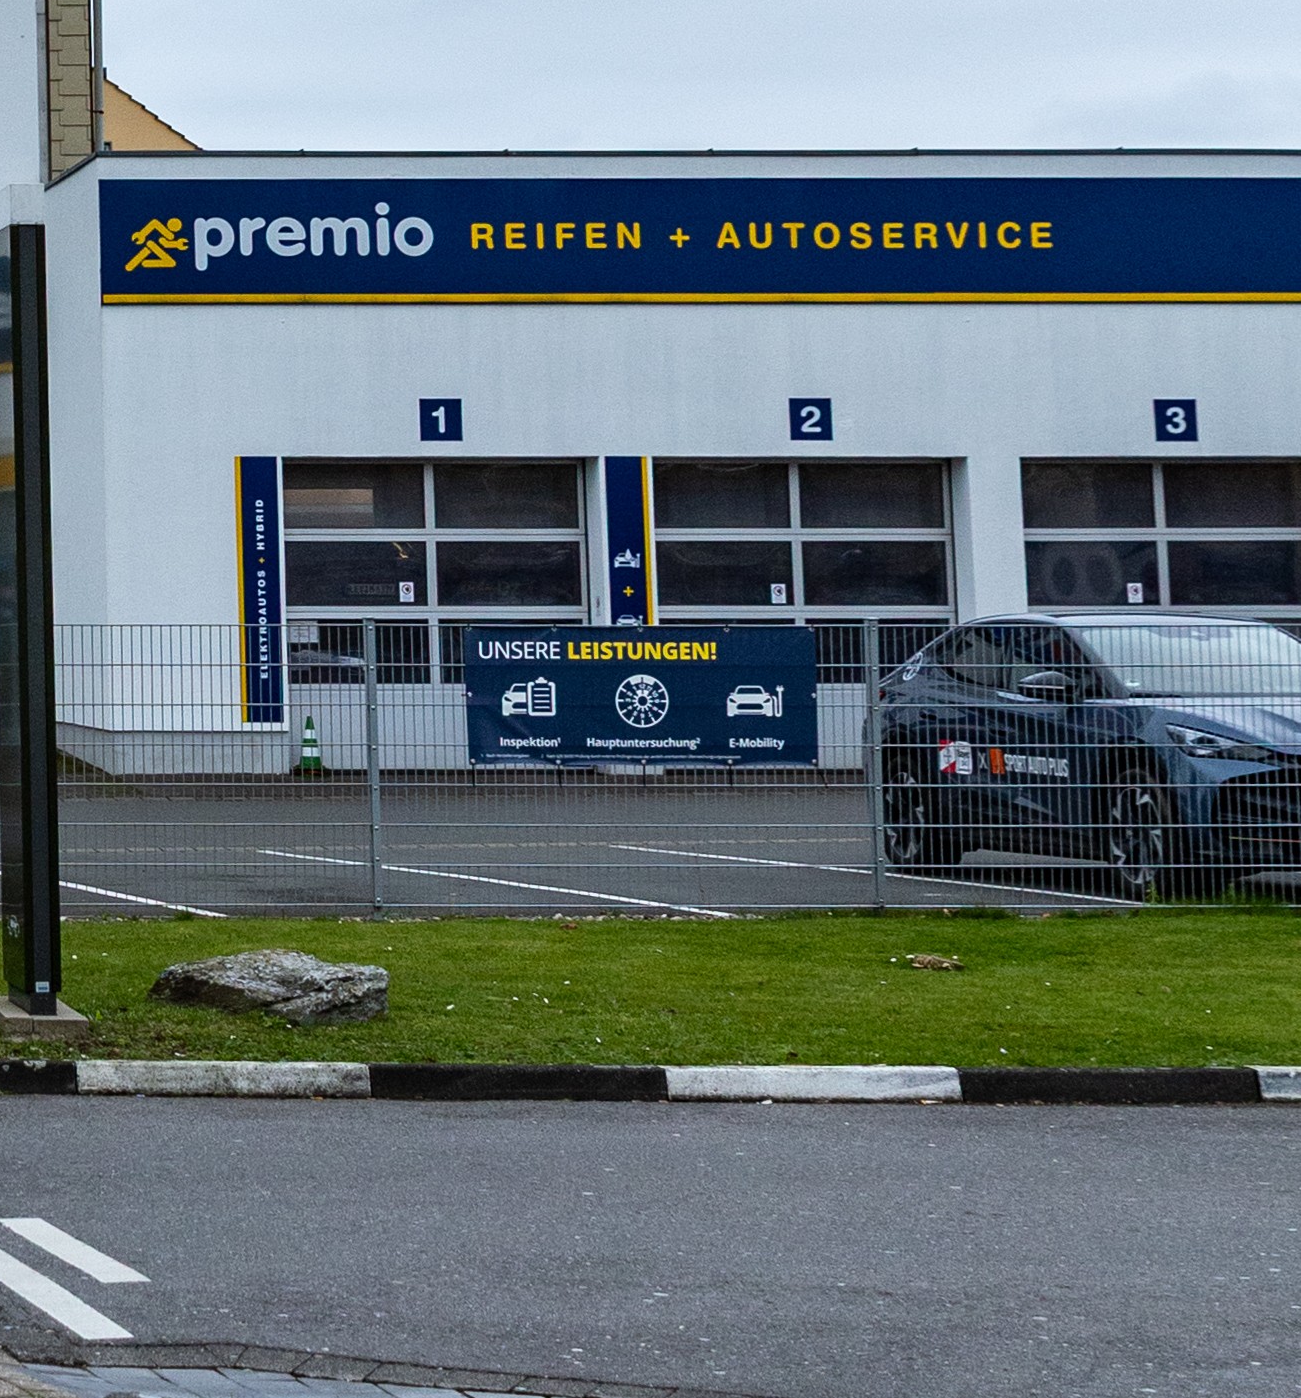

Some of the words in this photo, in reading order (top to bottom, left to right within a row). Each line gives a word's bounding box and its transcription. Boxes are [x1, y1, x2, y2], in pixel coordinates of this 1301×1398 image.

[194, 202, 434, 269] premio
[471, 222, 641, 249] REIFEN
[669, 227, 690, 248] +
[716, 221, 1054, 250] AUTOSERVICE
[431, 407, 448, 434] 1
[799, 407, 823, 434] 2
[1163, 407, 1187, 434] 3
[255, 499, 266, 551] HYBRID
[257, 569, 269, 680] ELEKTROAUTOS
[478, 640, 562, 660] UNSERE
[567, 641, 717, 661] LEISTUNGEN!
[729, 737, 785, 751] E-Mobility
